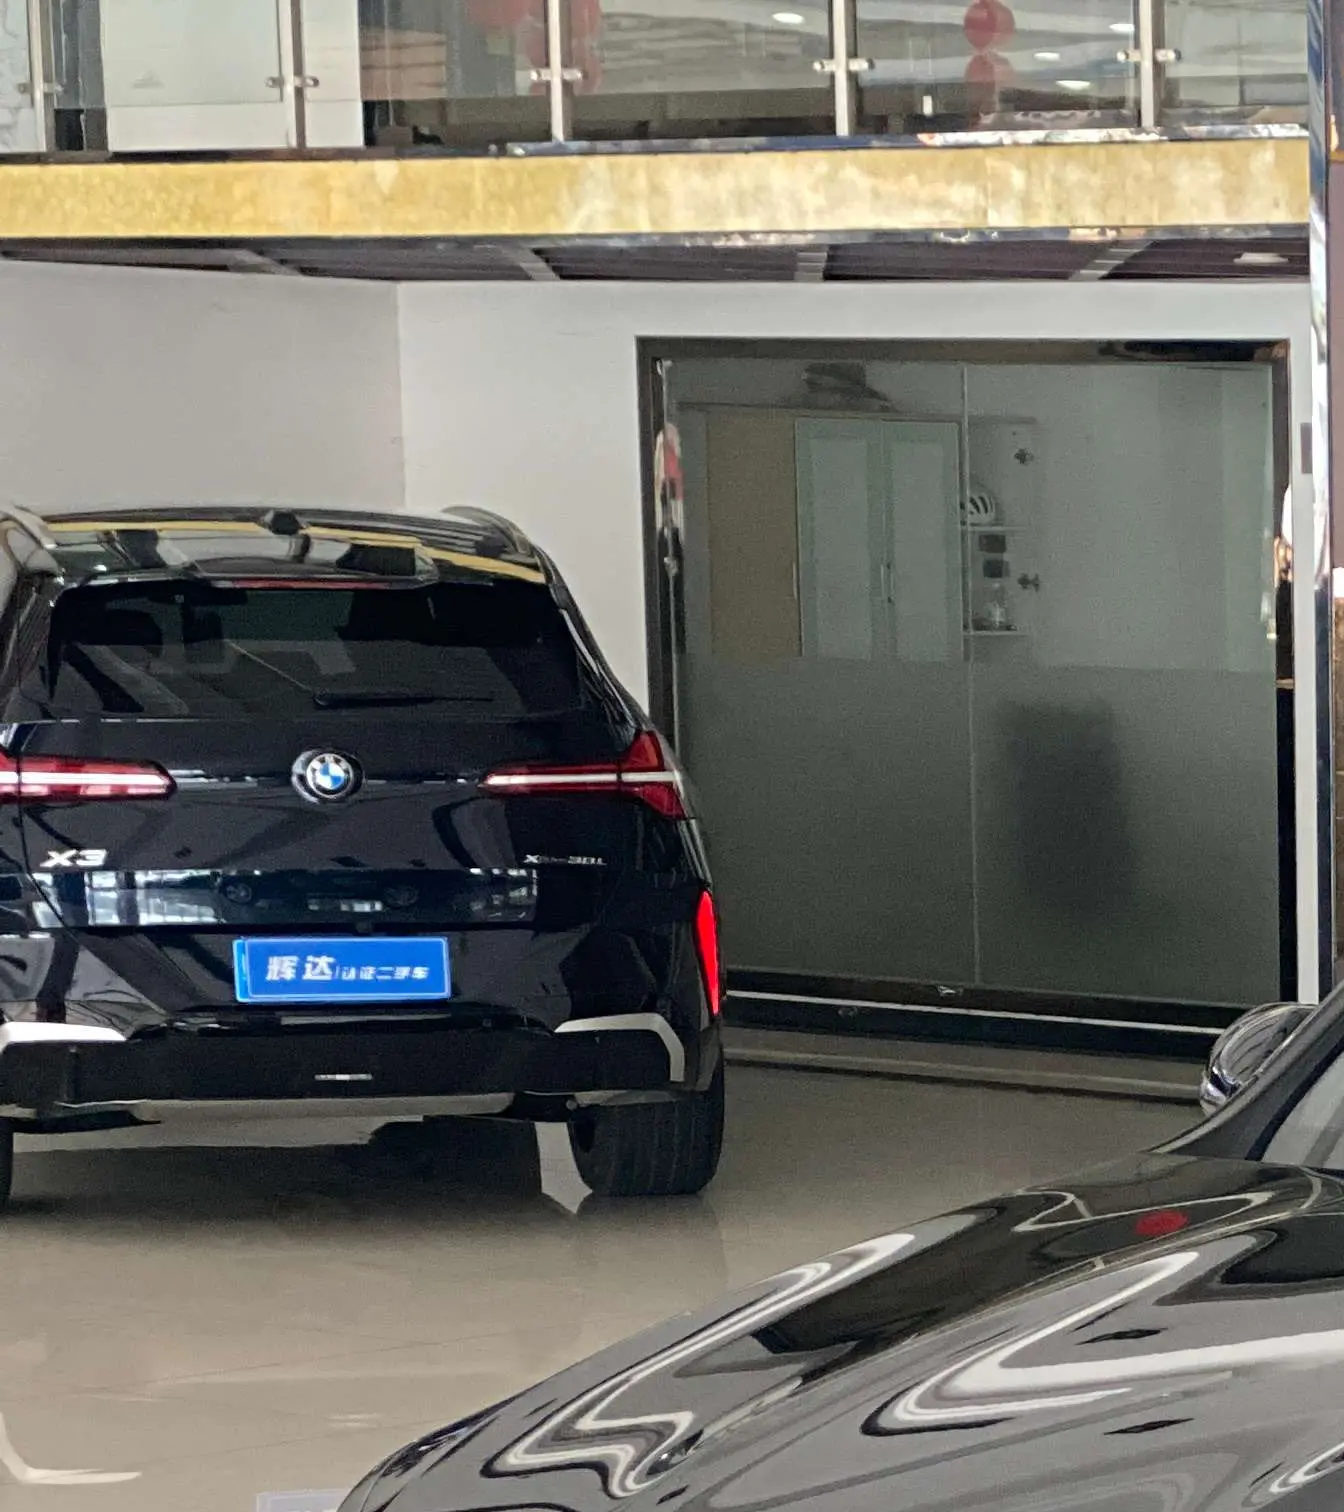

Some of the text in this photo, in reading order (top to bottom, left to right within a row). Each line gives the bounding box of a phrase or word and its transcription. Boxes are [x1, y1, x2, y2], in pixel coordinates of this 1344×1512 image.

[40, 849, 107, 867] X3
[266, 955, 430, 981] 辉达 认证二手车
